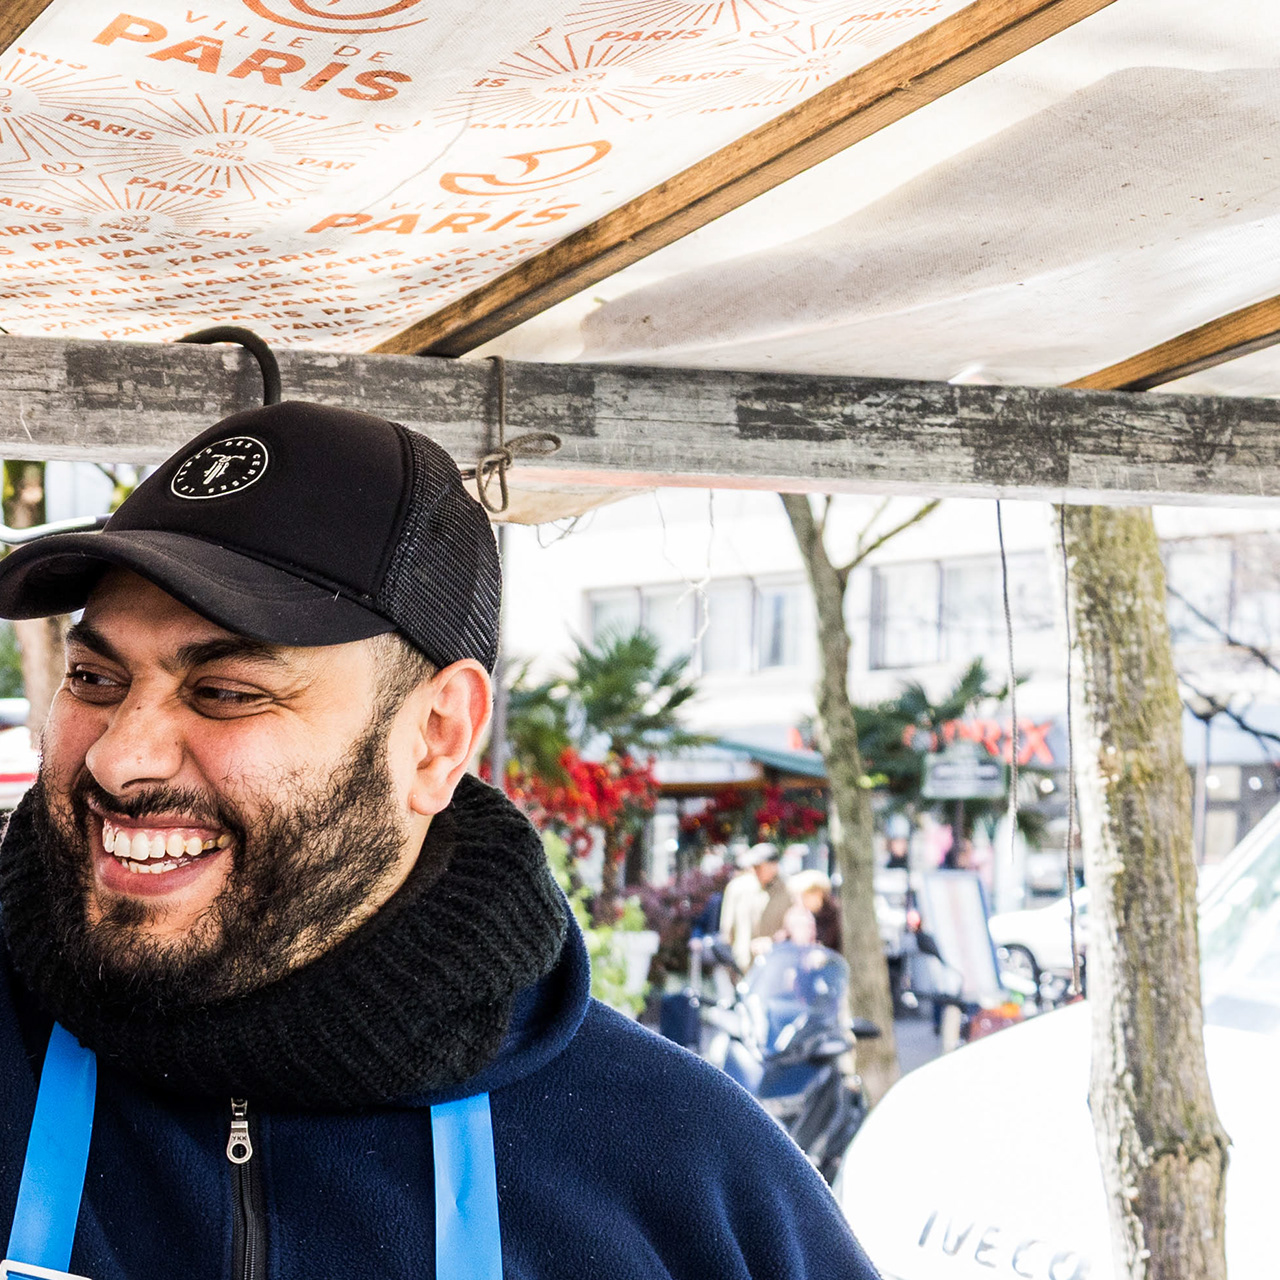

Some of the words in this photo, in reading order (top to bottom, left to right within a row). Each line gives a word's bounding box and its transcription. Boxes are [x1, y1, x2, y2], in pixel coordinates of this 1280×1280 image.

[185, 10, 313, 49] VILLE
[333, 45, 393, 63] DE
[595, 29, 709, 42] PARIS
[92, 12, 413, 101] PARIS
[651, 68, 747, 85] PARIS
[63, 113, 156, 141] PARIS
[193, 149, 245, 161] PARIS
[127, 176, 227, 199] PARIS
[303, 203, 582, 235] PARIS
[30, 233, 135, 251] PARIS
[99, 241, 204, 260] PARIS
[167, 245, 271, 266] PARIS
[234, 248, 339, 270] PARIS
[301, 249, 406, 273] PARIS
[182, 271, 283, 288] PARIS
[247, 274, 348, 291] PARIS
[67, 285, 165, 297] PARIS
[100, 318, 192, 340] PARIS
[225, 441, 252, 449] DES
